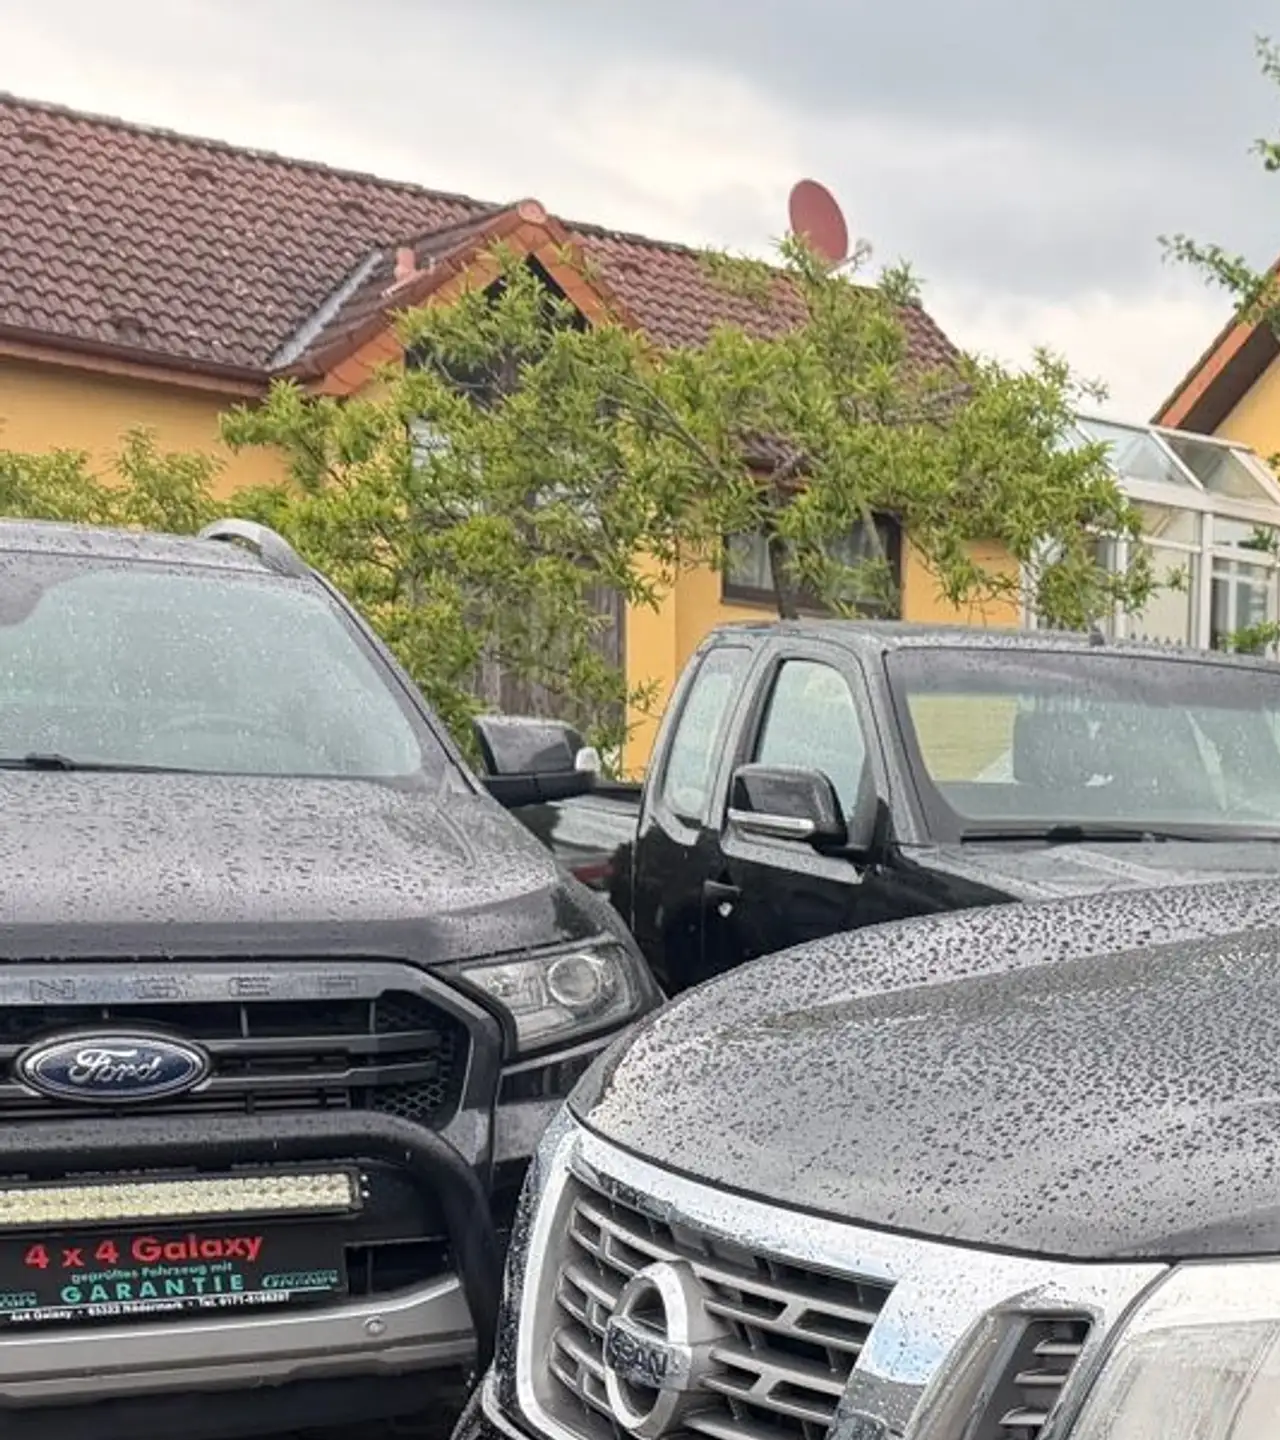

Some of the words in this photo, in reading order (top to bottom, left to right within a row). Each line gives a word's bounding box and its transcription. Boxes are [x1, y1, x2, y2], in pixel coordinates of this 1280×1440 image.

[68, 1048, 163, 1083] Ford
[24, 1244, 49, 1269] 4
[95, 1240, 119, 1264] 4
[131, 1234, 263, 1262] Galaxy
[211, 1261, 233, 1273] mit
[60, 1274, 244, 1303] GARANTIE
